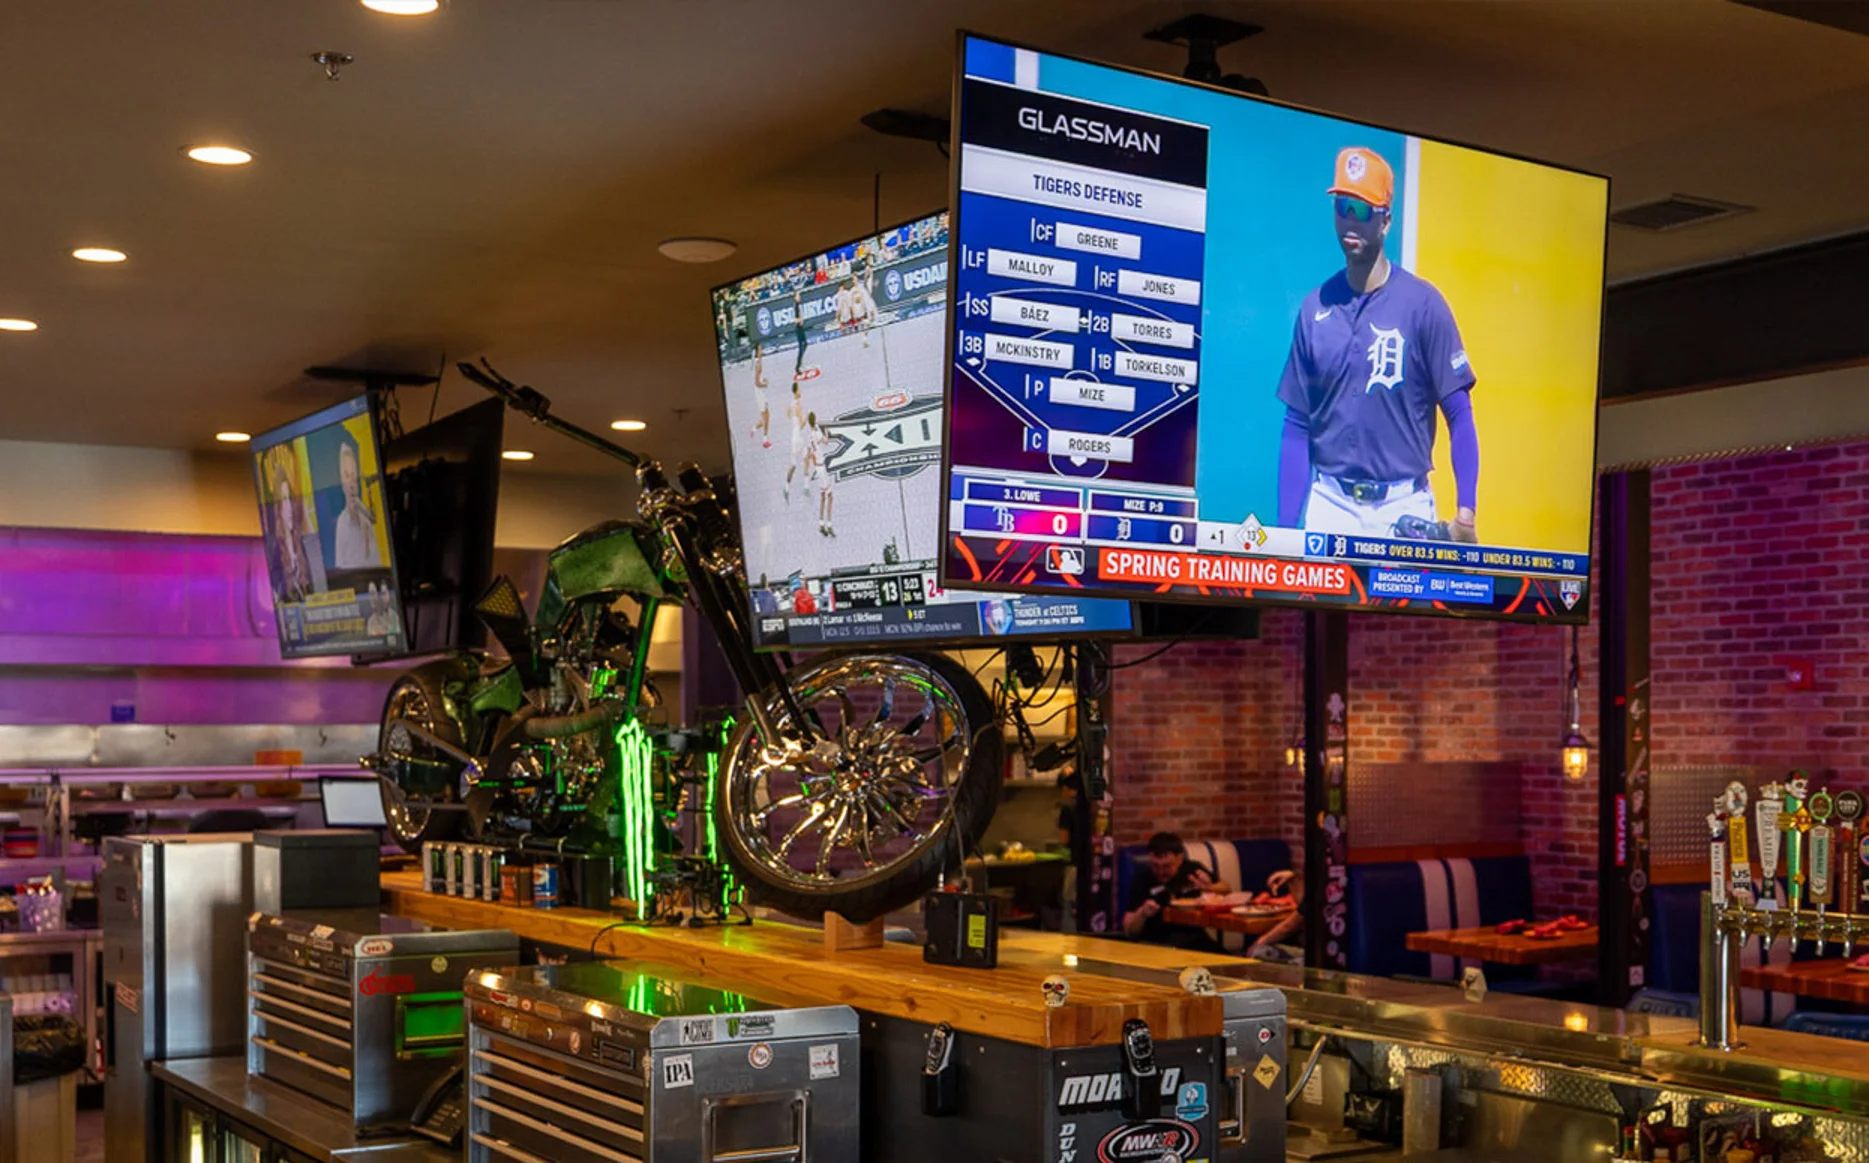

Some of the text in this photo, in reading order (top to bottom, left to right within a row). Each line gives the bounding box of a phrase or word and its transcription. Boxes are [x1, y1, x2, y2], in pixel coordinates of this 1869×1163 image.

[1018, 107, 1161, 155] GLASSMAN
[1033, 174, 1143, 208] TIGERS DEFENSE
[1036, 222, 1119, 251] CF GREENE
[967, 249, 1055, 277] LF MALLOY
[1100, 270, 1176, 296] RF JONES
[971, 296, 1050, 322] SS BÁEZ
[1093, 315, 1173, 340] 2B TORRES
[965, 335, 1061, 362] 3B MCKINSTRY
[1098, 353, 1186, 377] 1B TORKELSON
[1034, 379, 1105, 402] P MIZE
[1031, 432, 1111, 455] C ROGERS
[1015, 489, 1041, 503] LOWE
[1123, 499, 1146, 512] MIZE
[993, 506, 1067, 534] TB 0
[1170, 524, 1183, 544] 0
[1219, 530, 1225, 544] 1
[1354, 541, 1386, 555] TIGERS
[1389, 544, 1413, 557] OVER
[1415, 547, 1434, 559] 83.5
[1436, 548, 1460, 561] WINS:
[1462, 551, 1479, 563] -110
[1483, 552, 1510, 565] UNDER
[1512, 554, 1530, 567] 83.5
[1532, 556, 1556, 569] WINS:
[1106, 552, 1346, 590] SPRING TRAINING GAMES
[1378, 572, 1421, 584] BROADCAST
[882, 580, 899, 602] 13
[1373, 581, 1425, 594] PRESENTED BY
[666, 1062, 691, 1084] IPA
